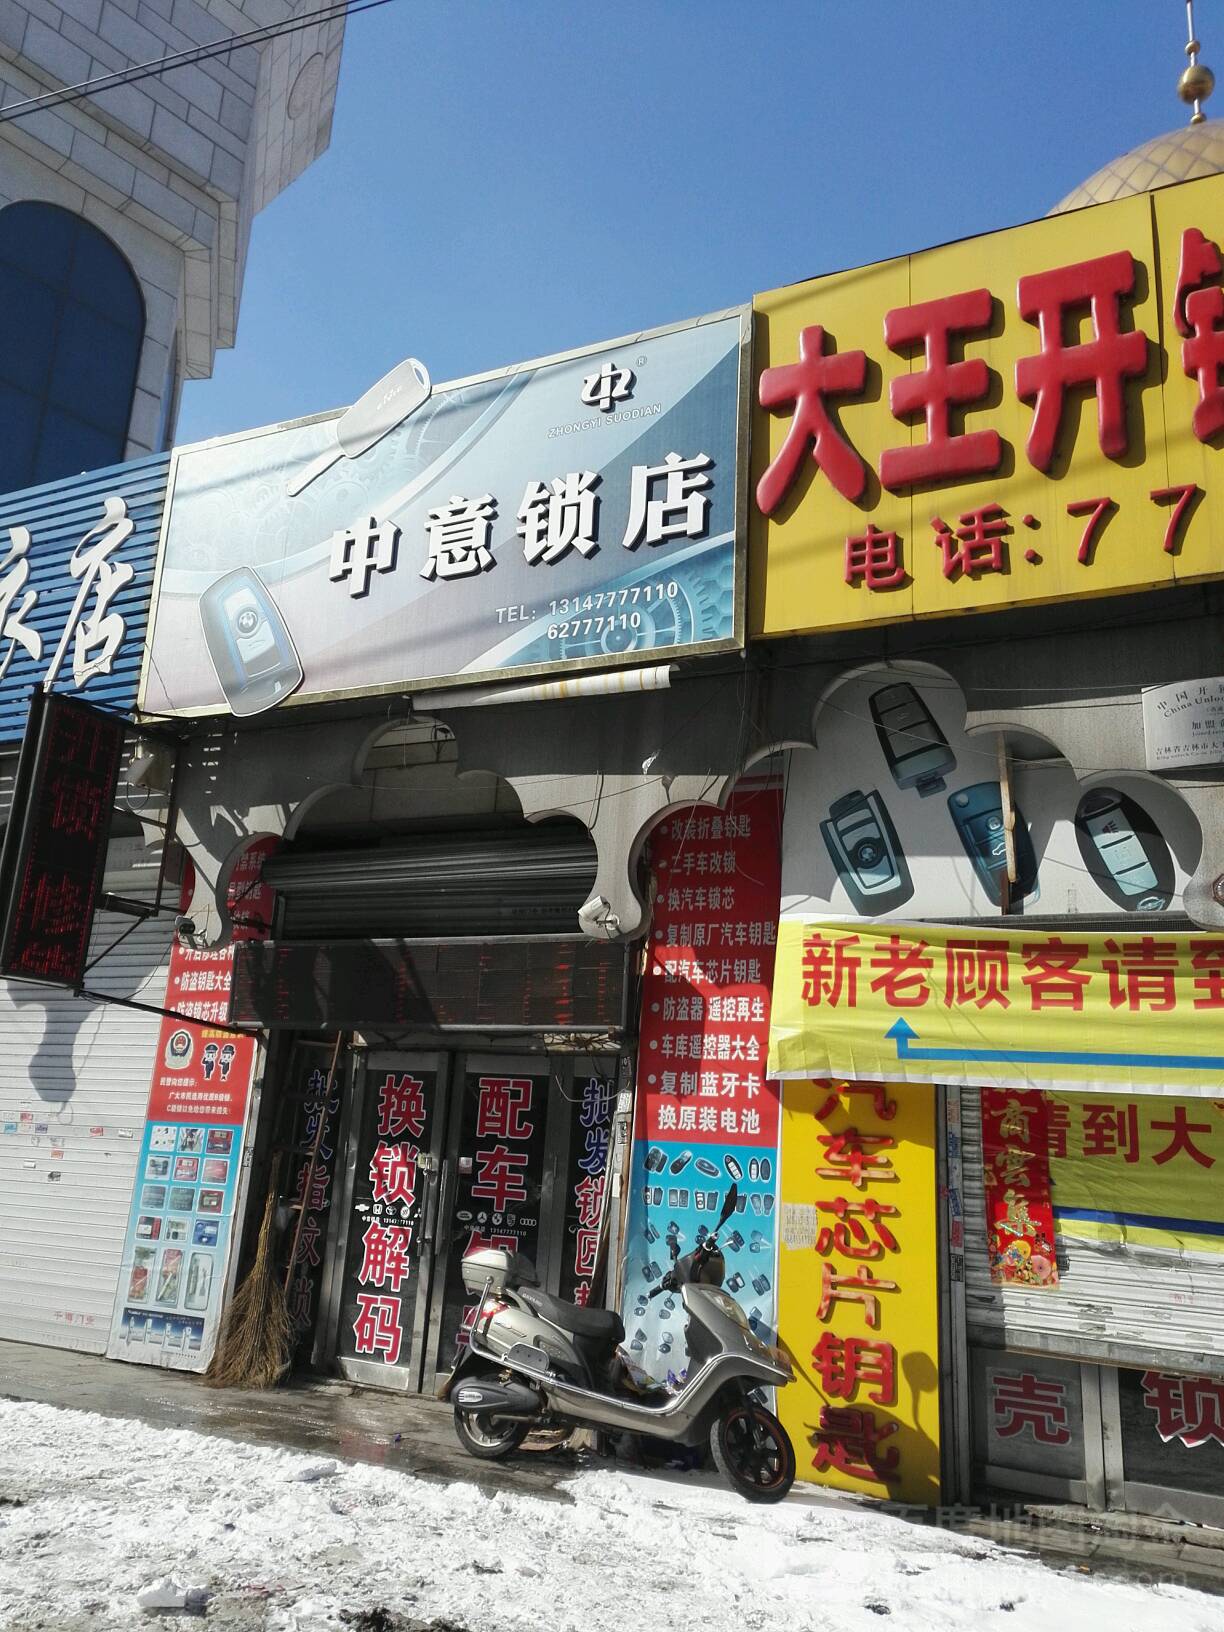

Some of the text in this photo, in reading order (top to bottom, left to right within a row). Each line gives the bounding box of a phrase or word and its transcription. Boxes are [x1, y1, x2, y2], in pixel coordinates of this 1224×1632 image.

[547, 402, 662, 439] ZHONGYI SUODIAN
[328, 451, 715, 598] 中意锁店
[548, 581, 678, 616] 13147777110
[547, 612, 641, 640] 62777110
[669, 850, 737, 877] 二手车改锁
[667, 886, 735, 912] 换汽车锁芯
[666, 921, 778, 949] 复制原厂汽车钥匙
[664, 958, 762, 984] 配汽车芯片钥匙
[660, 1033, 761, 1062] 车库遥控器大全
[659, 1071, 762, 1099] 复制蓝牙卡
[657, 1103, 761, 1135] 换原装电池
[353, 1073, 427, 1366] 换锁解码
[992, 1373, 1073, 1447] 壳
